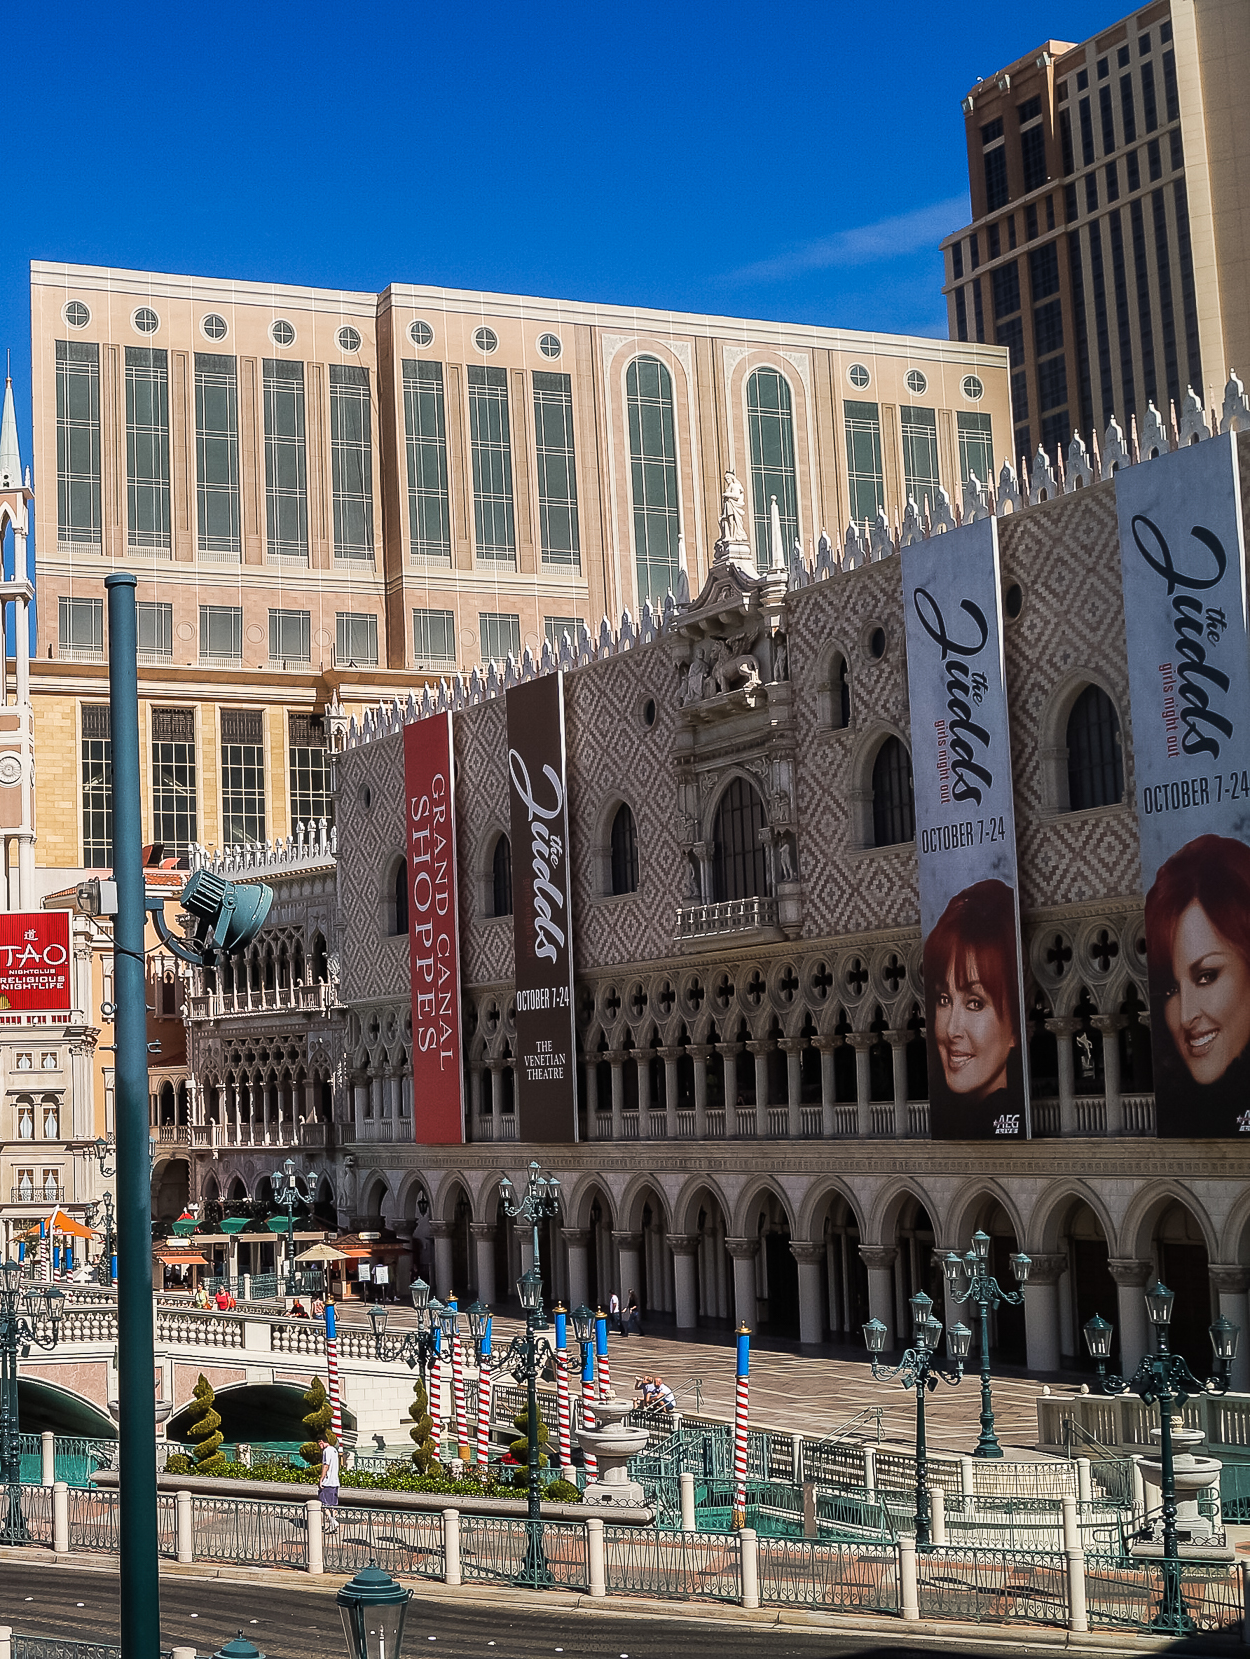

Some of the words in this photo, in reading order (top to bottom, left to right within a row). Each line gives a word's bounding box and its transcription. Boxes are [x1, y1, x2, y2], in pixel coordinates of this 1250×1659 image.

[1205, 606, 1228, 648] the
[971, 671, 989, 708] the
[1158, 662, 1177, 693] girls
[1161, 696, 1180, 732] night
[934, 719, 949, 747] girls
[1166, 735, 1180, 758] out
[936, 749, 950, 781] night
[940, 784, 951, 804] out
[1143, 776, 1210, 814] OCTOBER
[1214, 770, 1250, 803] 7-24
[431, 773, 449, 916] GRAND
[921, 821, 974, 854] OCTOBER
[977, 815, 1006, 844] 7-24
[550, 835, 563, 869] the
[411, 795, 438, 1052] SHOPPES
[0, 975, 65, 983] RELIGIOUS
[436, 933, 454, 1071] CANAL
[516, 988, 550, 1011] OCTOBER
[552, 986, 569, 1008] 7-24
[524, 1053, 566, 1067] VENETIAN
[536, 1040, 552, 1052] THE
[526, 1067, 564, 1080] THEATRE
